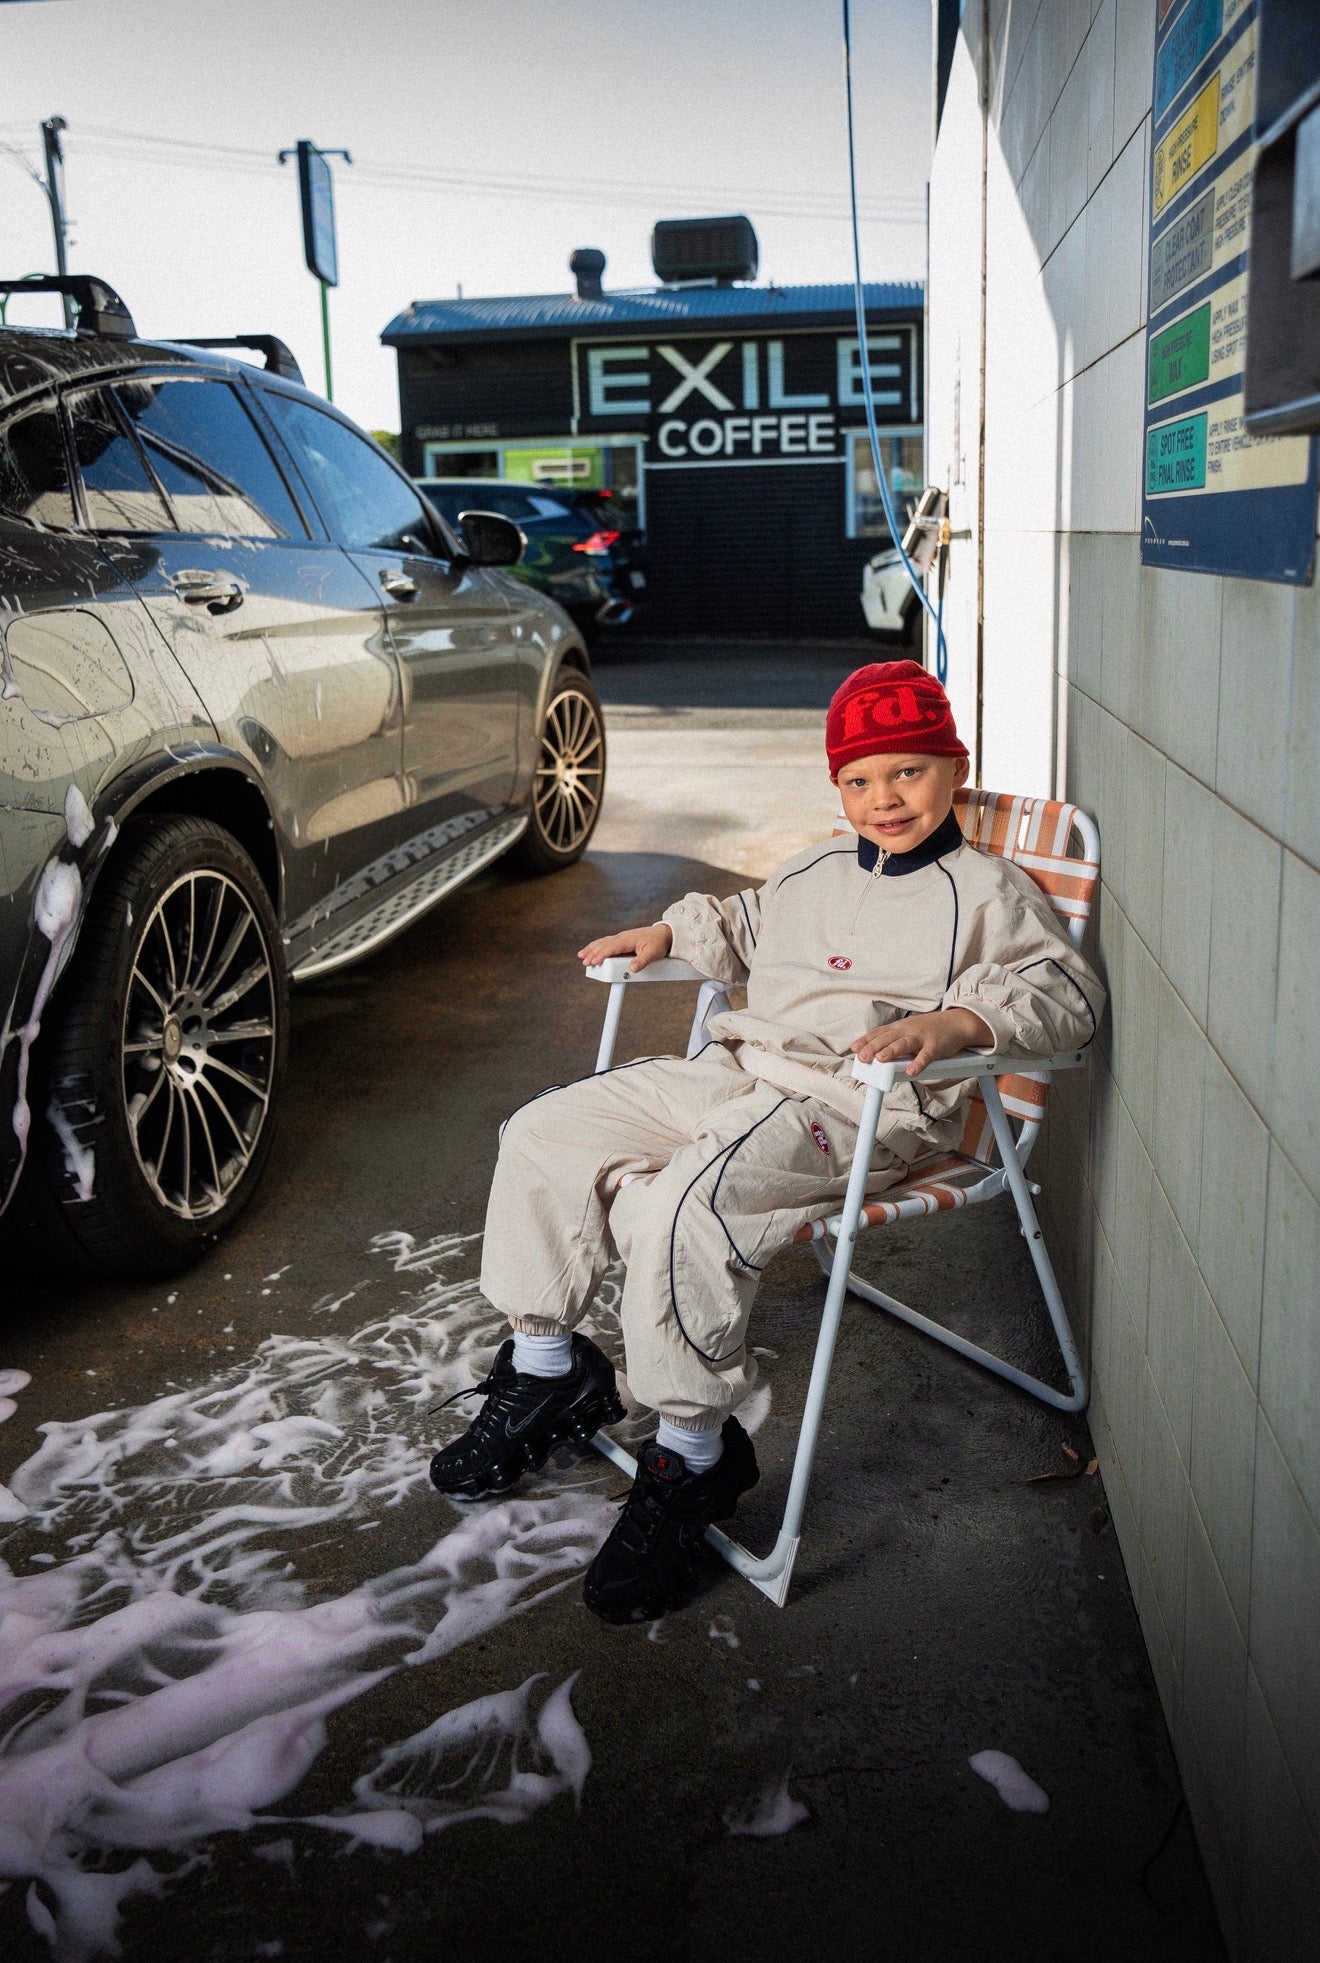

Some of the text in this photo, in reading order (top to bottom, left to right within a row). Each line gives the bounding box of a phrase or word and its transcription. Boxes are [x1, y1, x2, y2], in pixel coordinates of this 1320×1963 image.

[1172, 143, 1192, 186] RINSE
[1165, 207, 1206, 264] CLEAR COAT
[1164, 239, 1205, 294] PROTECTANT
[587, 336, 902, 416] EXILE
[1168, 356, 1183, 384] WAX
[657, 414, 836, 457] COFFEE
[1161, 426, 1194, 458] SPOT FREE
[1159, 462, 1174, 486] FINAL
[1176, 457, 1195, 483] RINSE
[841, 686, 937, 741] fd.
